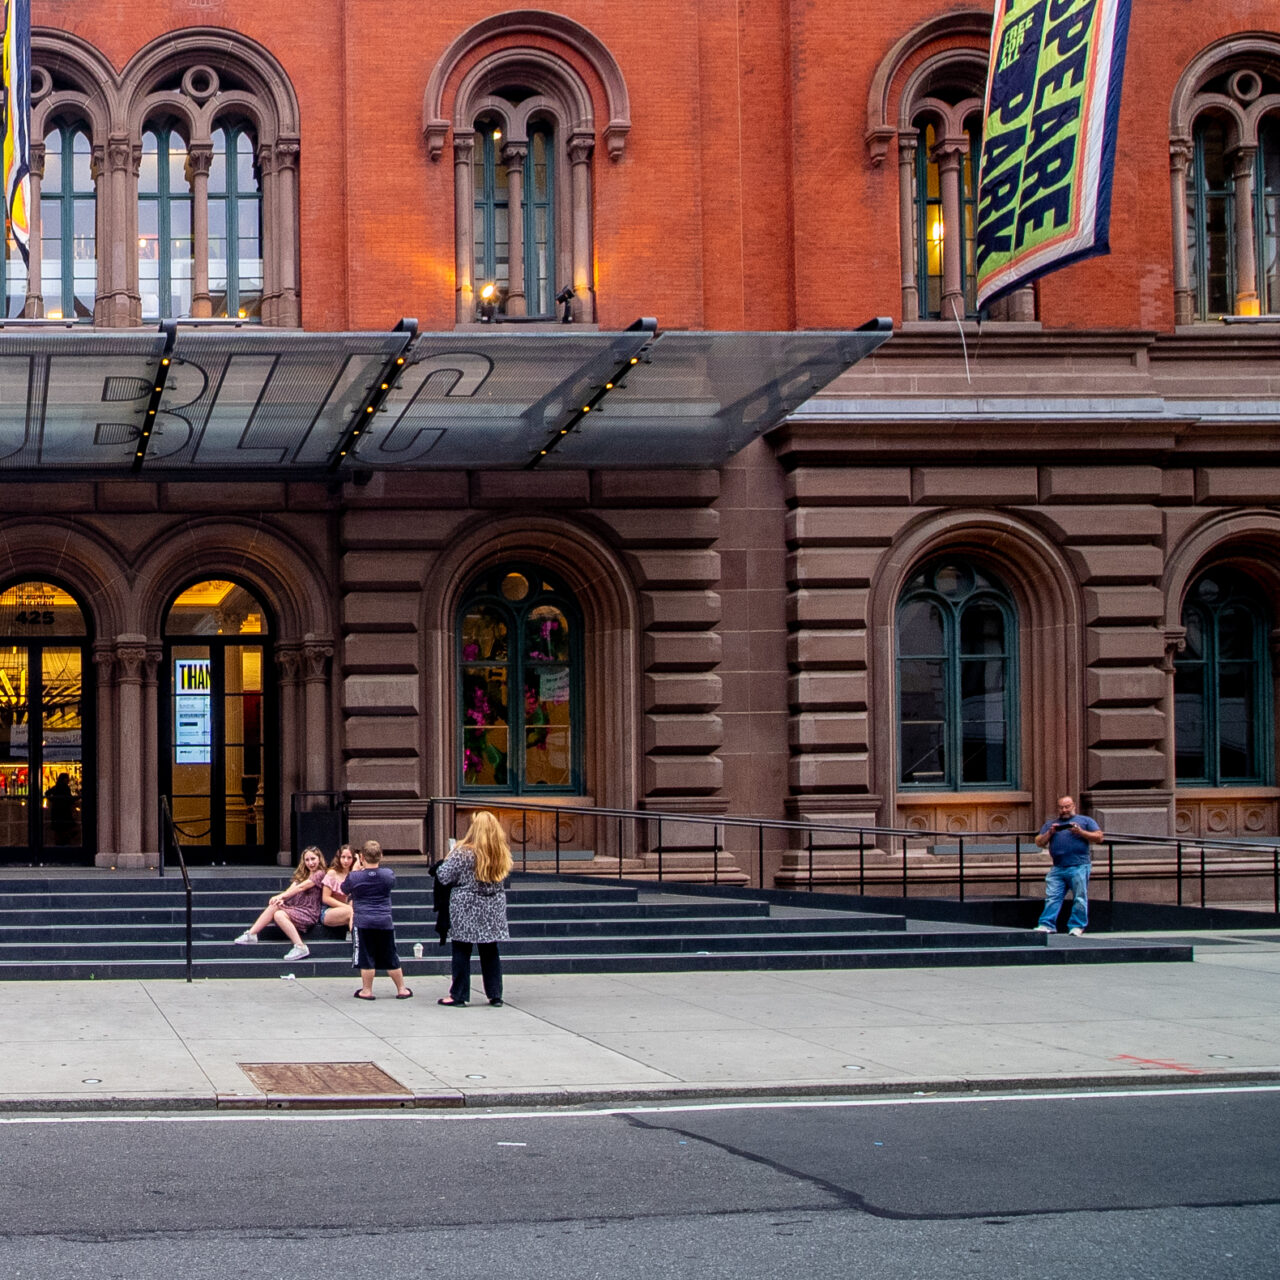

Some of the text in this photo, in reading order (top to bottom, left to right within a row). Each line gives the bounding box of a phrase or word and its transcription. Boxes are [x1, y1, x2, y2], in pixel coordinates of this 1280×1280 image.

[1004, 12, 1034, 45] FREE
[1002, 31, 1025, 59] FOR
[998, 46, 1020, 73] ALL
[16, 611, 54, 624] 425
